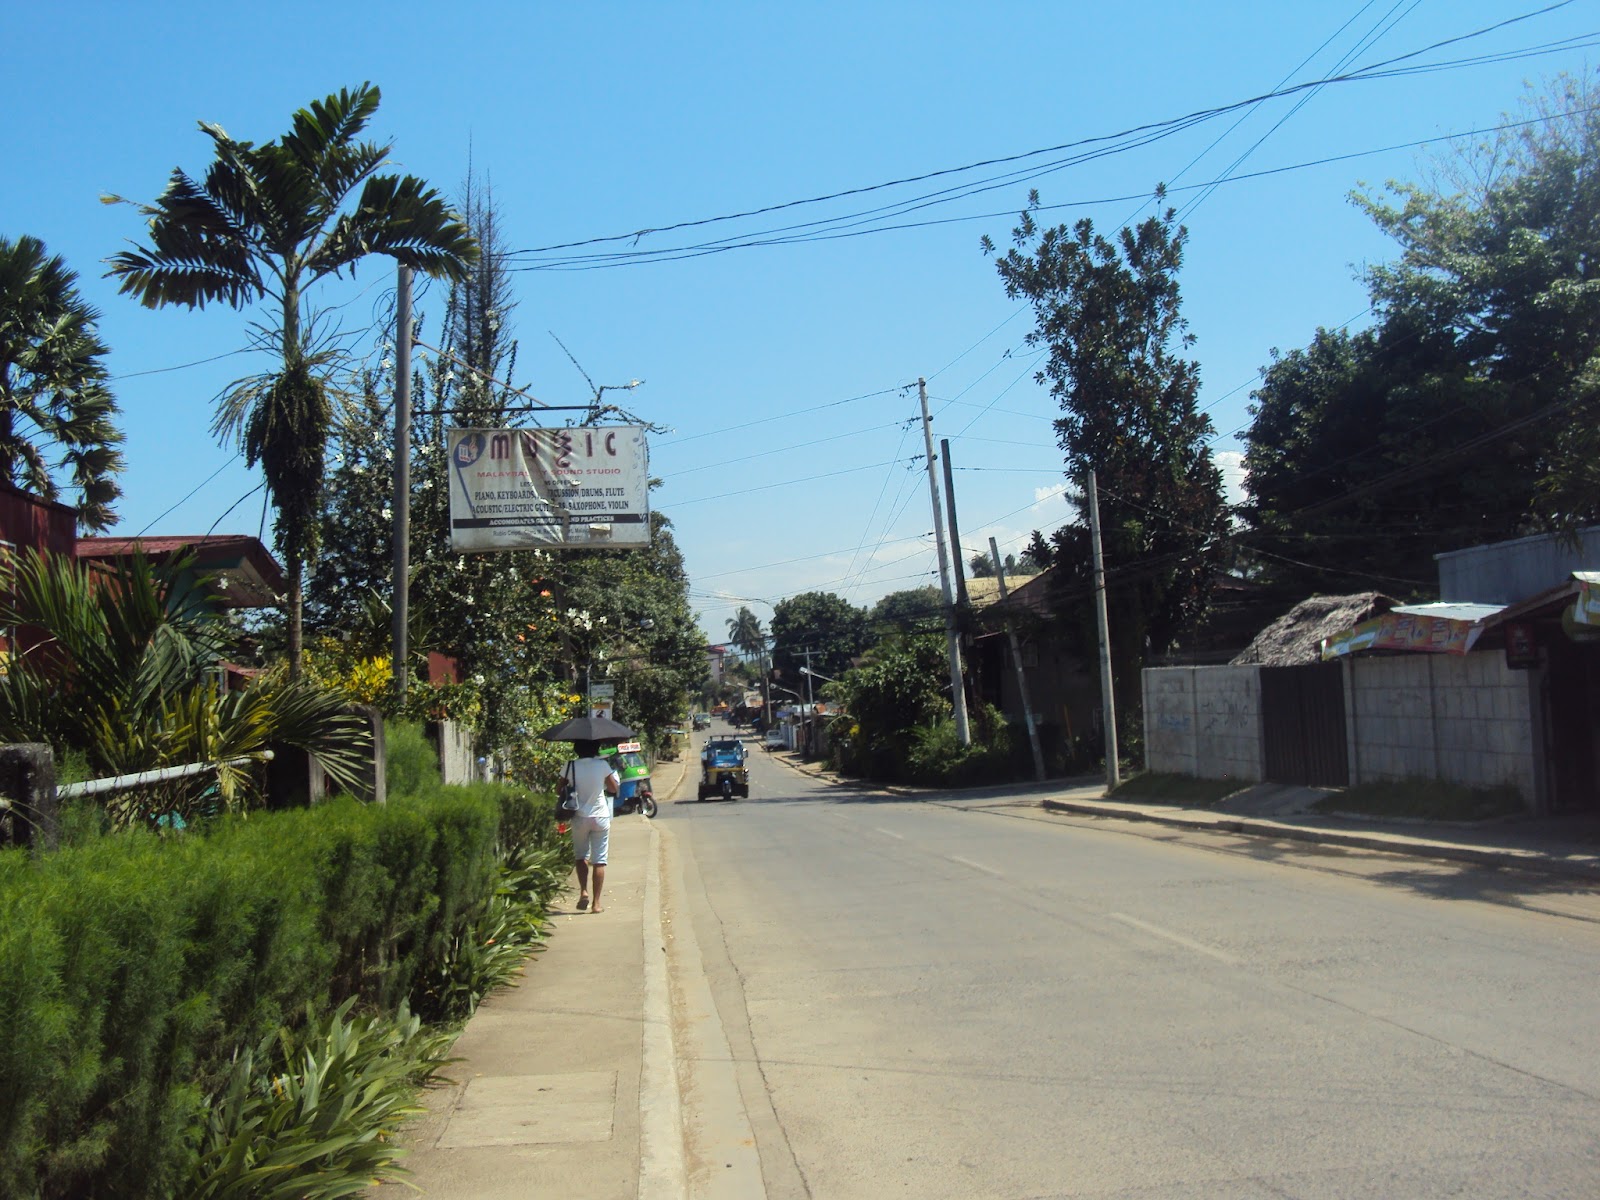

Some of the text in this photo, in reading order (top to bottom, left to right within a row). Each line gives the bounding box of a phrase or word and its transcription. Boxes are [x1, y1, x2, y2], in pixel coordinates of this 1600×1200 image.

[477, 470, 548, 478] MALAYBALY
[605, 488, 625, 496] FLUTE
[472, 503, 533, 514] ACOUSTIC/ELECTRIC
[568, 501, 607, 511] SAXOPHONE,
[608, 501, 629, 510] VIOLIN
[580, 515, 615, 523] PRACTICES
